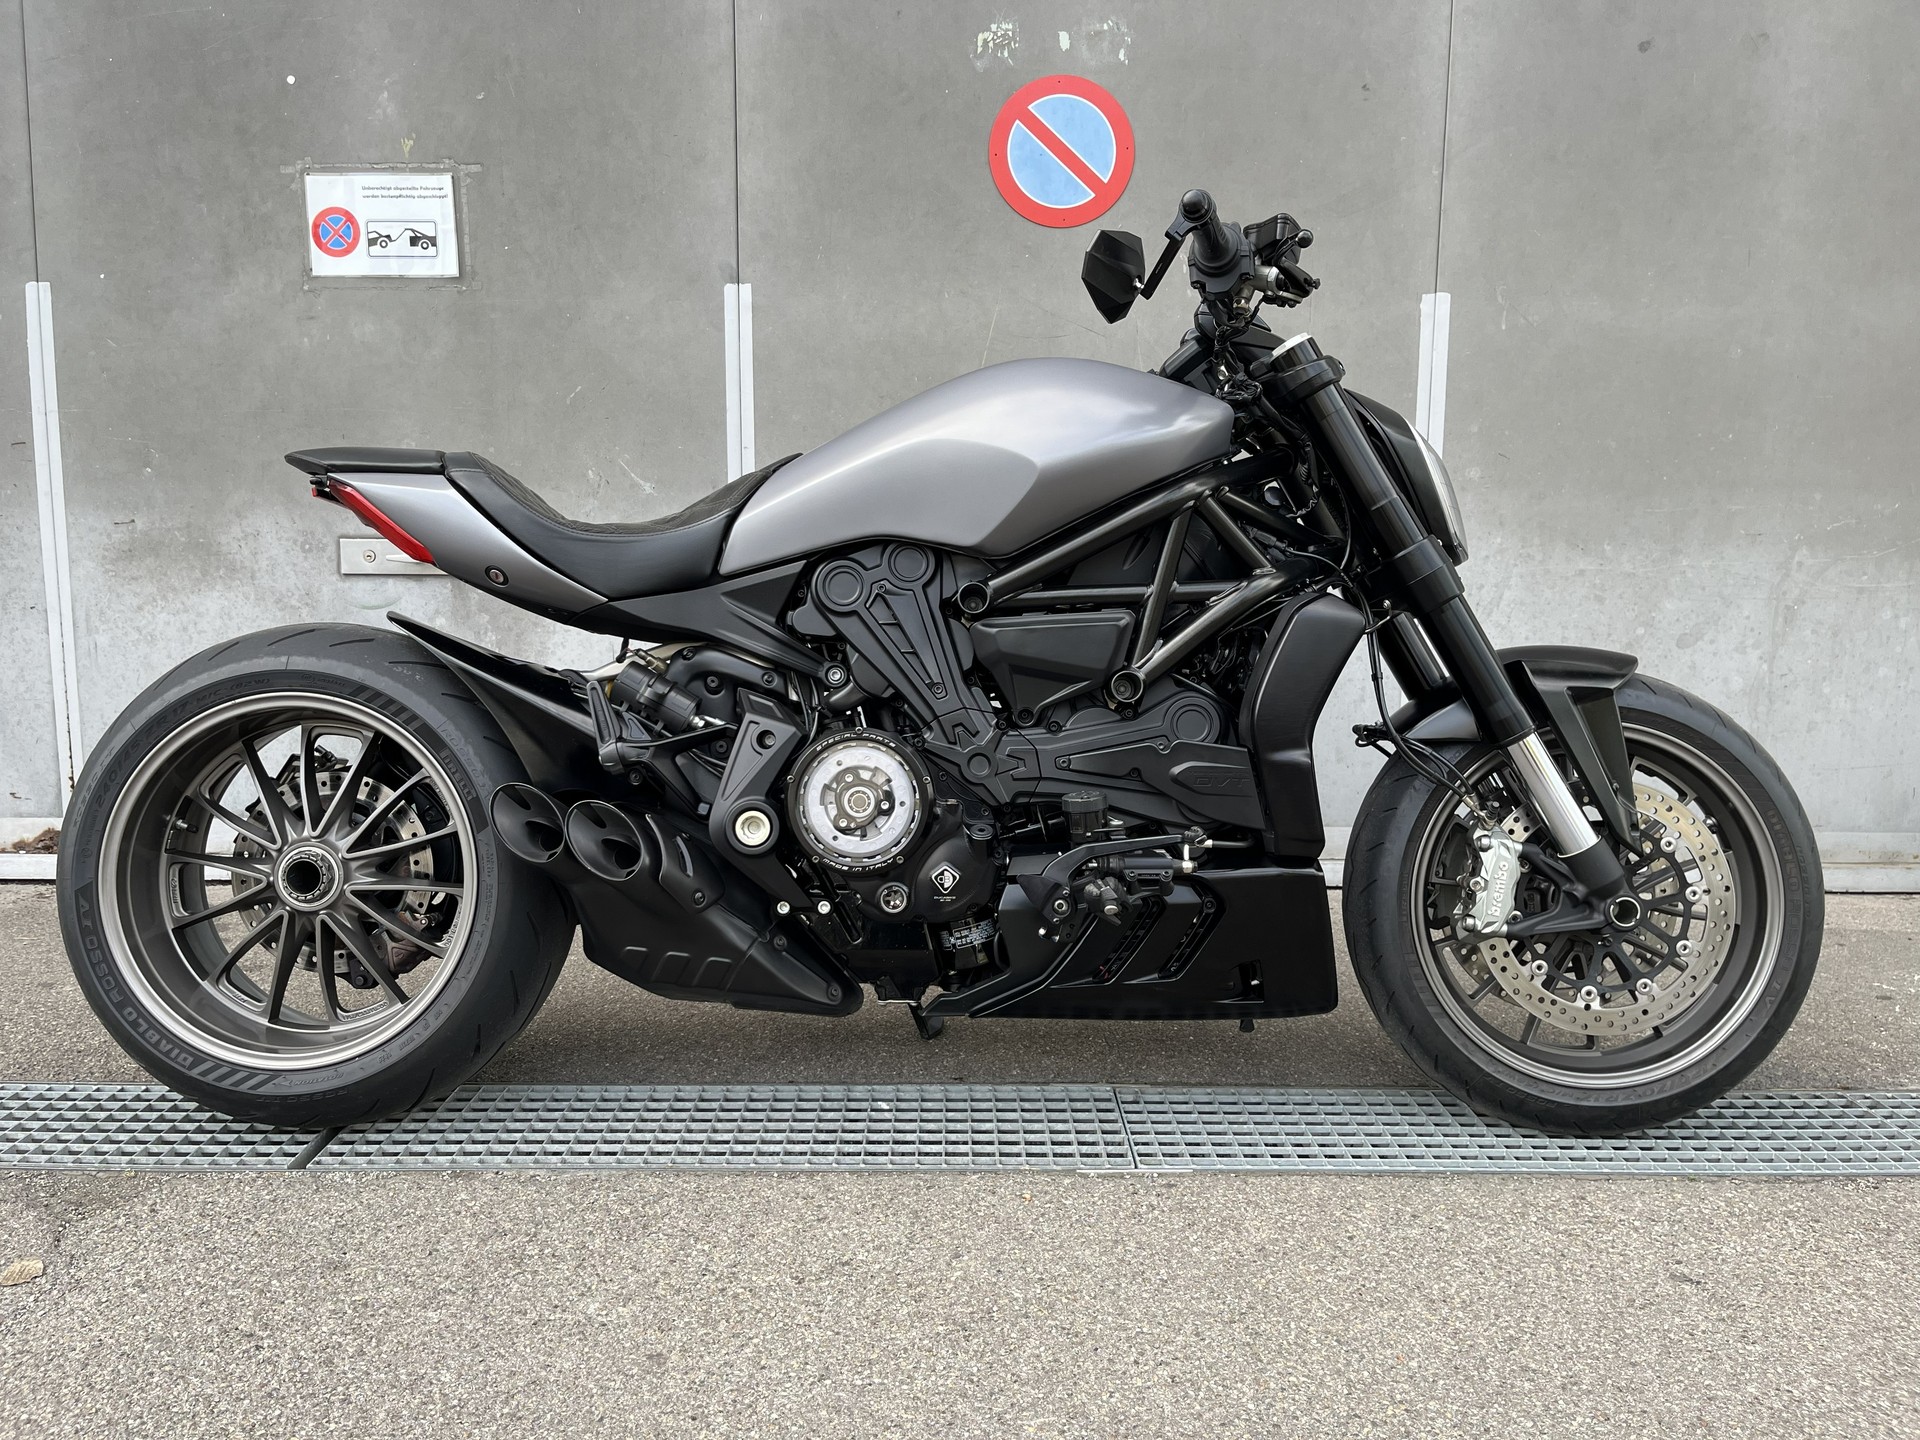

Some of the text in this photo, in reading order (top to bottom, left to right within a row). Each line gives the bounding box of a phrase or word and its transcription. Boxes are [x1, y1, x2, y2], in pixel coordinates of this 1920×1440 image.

[816, 733, 897, 752] SPECIAL PARTS
[438, 746, 477, 801] PIRELLI
[823, 857, 850, 871] MADE
[864, 857, 895, 872] ITALY
[1488, 861, 1509, 917] brembo
[77, 890, 94, 933] IV
[83, 933, 125, 1005] ROSSO
[120, 1004, 195, 1069] DIABLO
